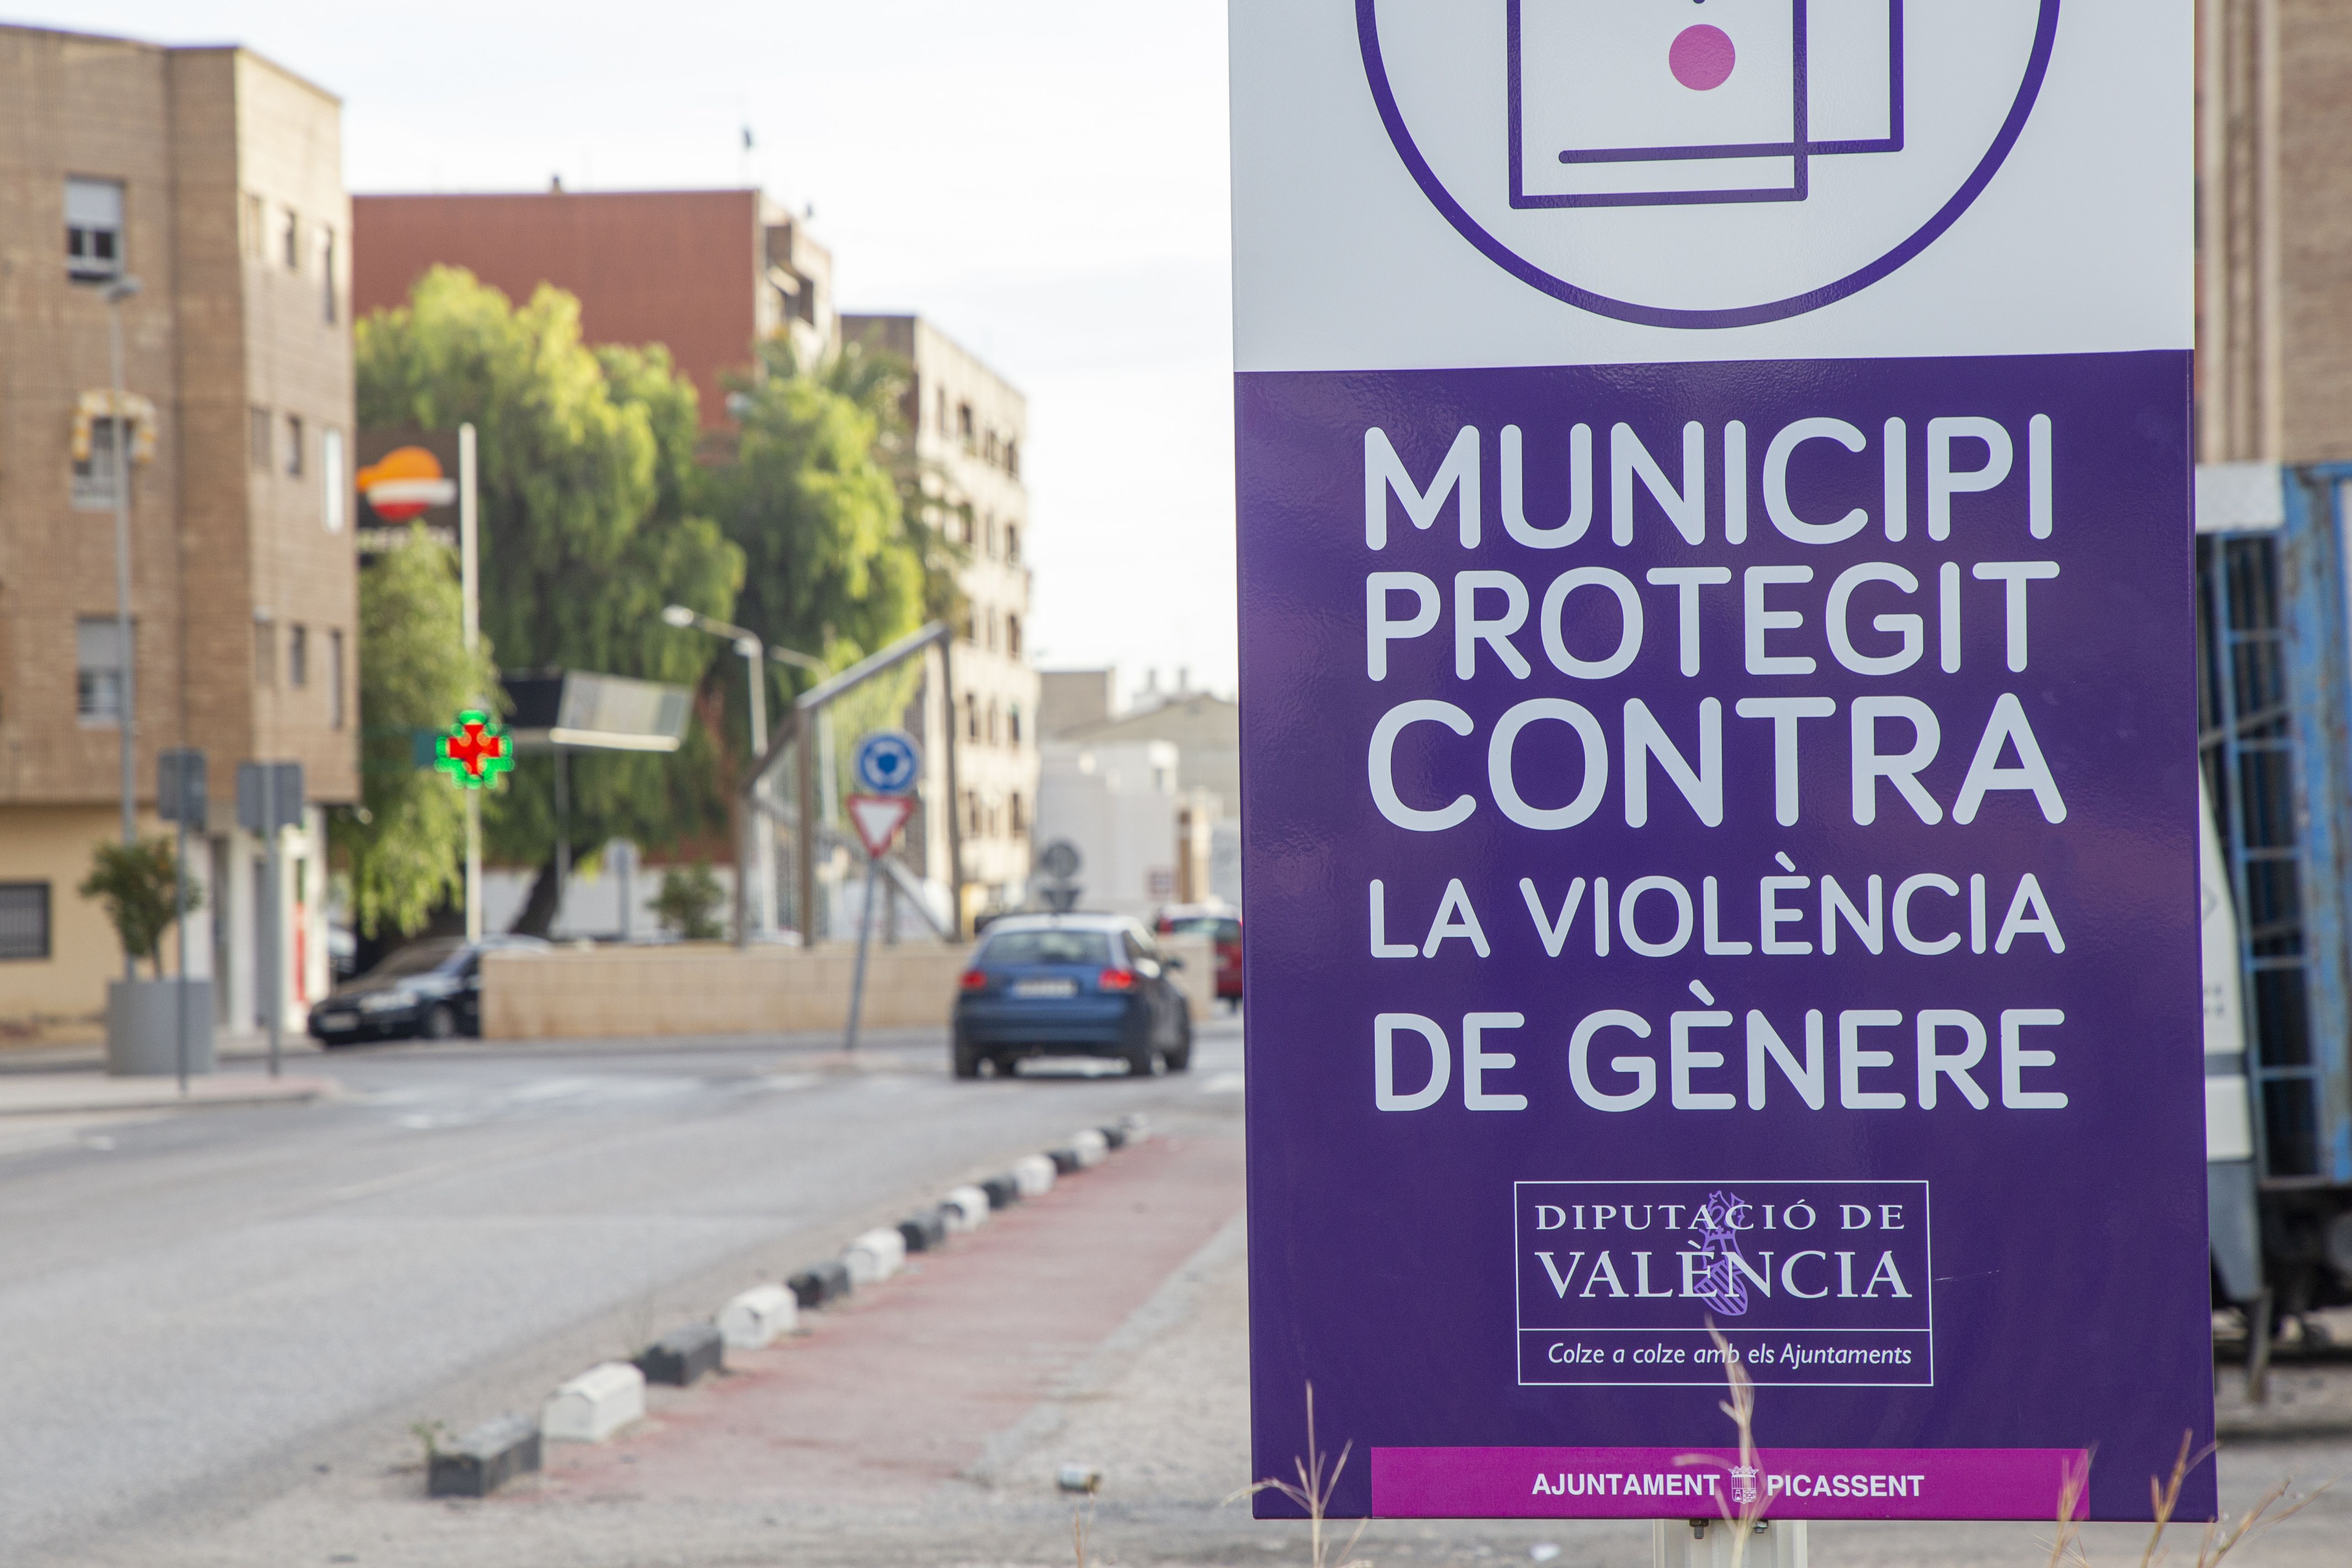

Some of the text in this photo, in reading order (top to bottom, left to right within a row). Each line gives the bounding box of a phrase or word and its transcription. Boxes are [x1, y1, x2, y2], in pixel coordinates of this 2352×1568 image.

[1364, 413, 2053, 551] MUNICIPI
[1366, 561, 2060, 681] PROTEGIT
[1368, 693, 2067, 832] CONTRA
[1369, 851, 2065, 958] LA VIOLÈNCIA
[1374, 979, 2069, 1112] DE GÈNERE
[1535, 1199, 1904, 1230] DIPUTACIÓ DE
[1534, 1240, 1913, 1299] VALÈNCIA
[1548, 1343, 1912, 1370] Colze a colze amb els Ajuntaments
[1532, 1473, 1924, 1497] AJUNTAMENT PICASSENT
